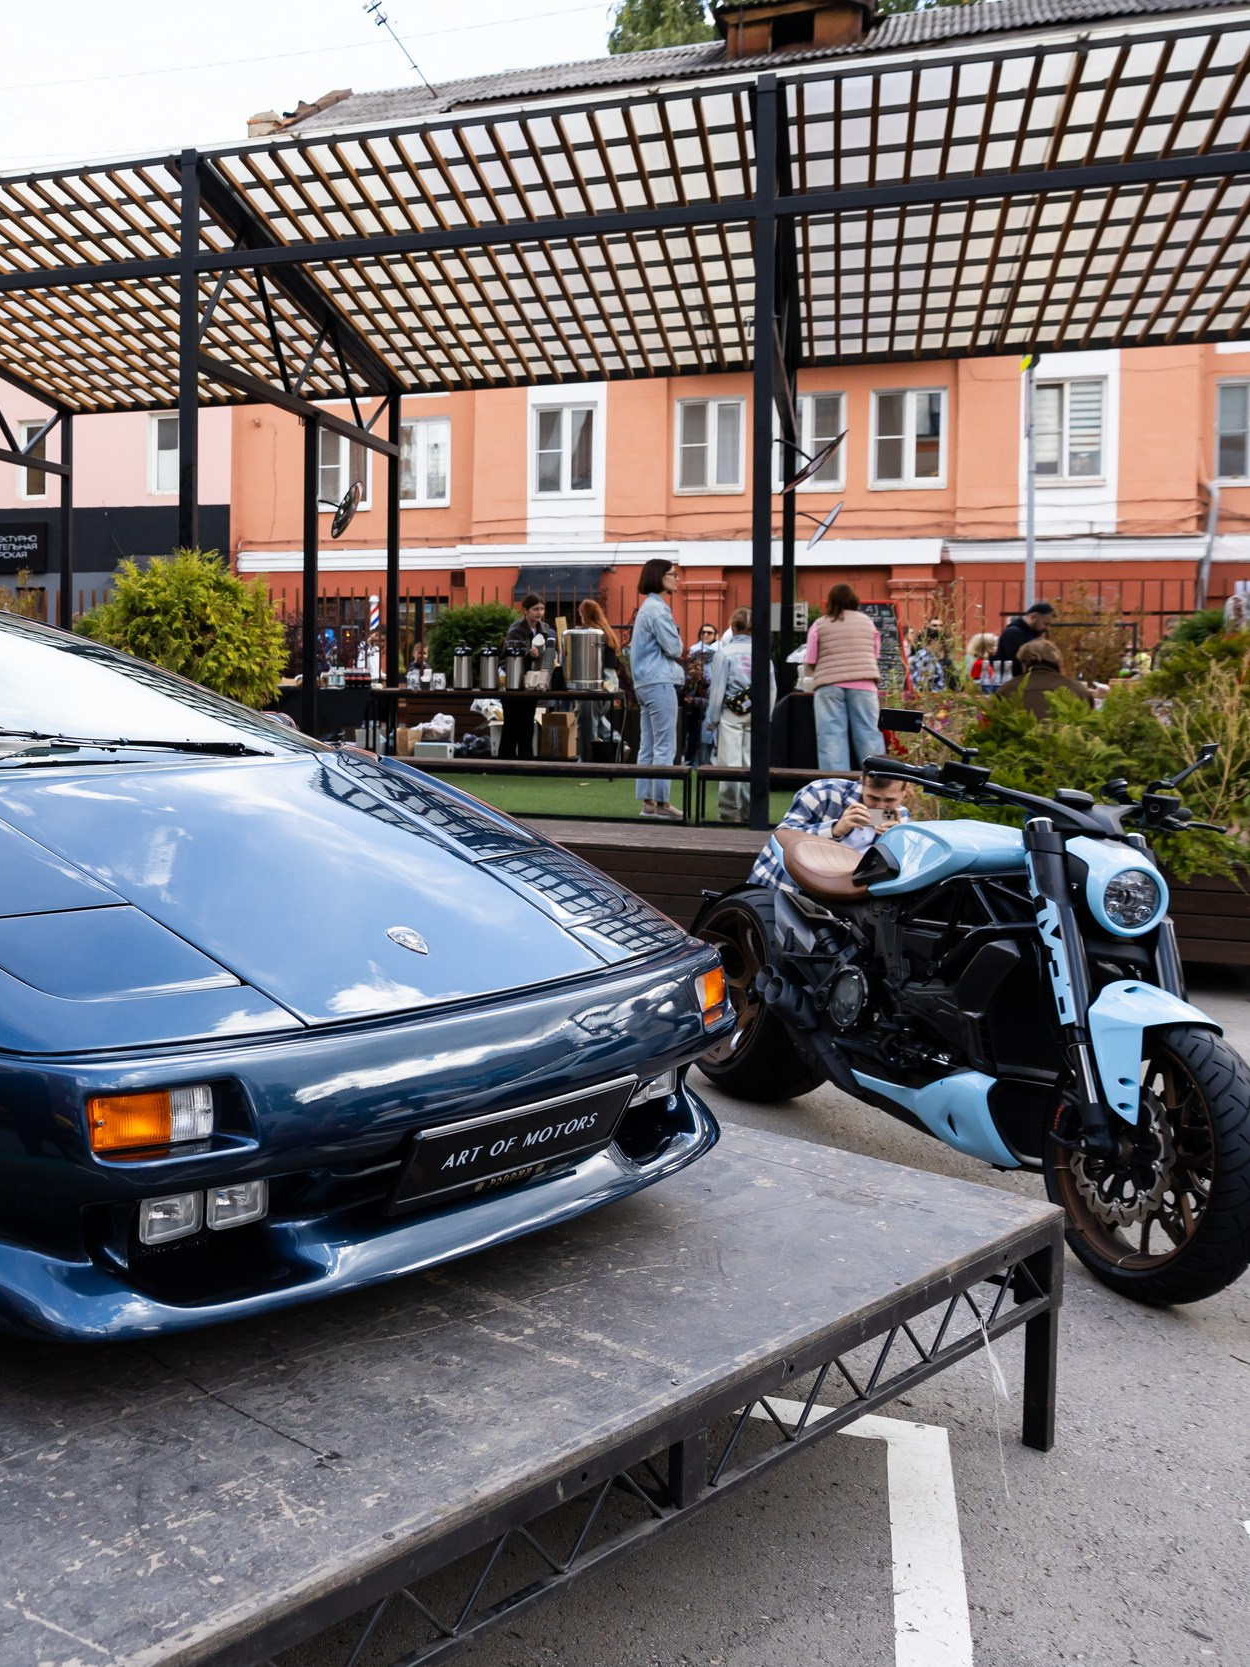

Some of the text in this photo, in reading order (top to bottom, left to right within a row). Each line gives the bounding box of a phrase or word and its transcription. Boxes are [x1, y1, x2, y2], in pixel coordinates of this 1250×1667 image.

[441, 1112, 599, 1171] ART OF MOTORS
